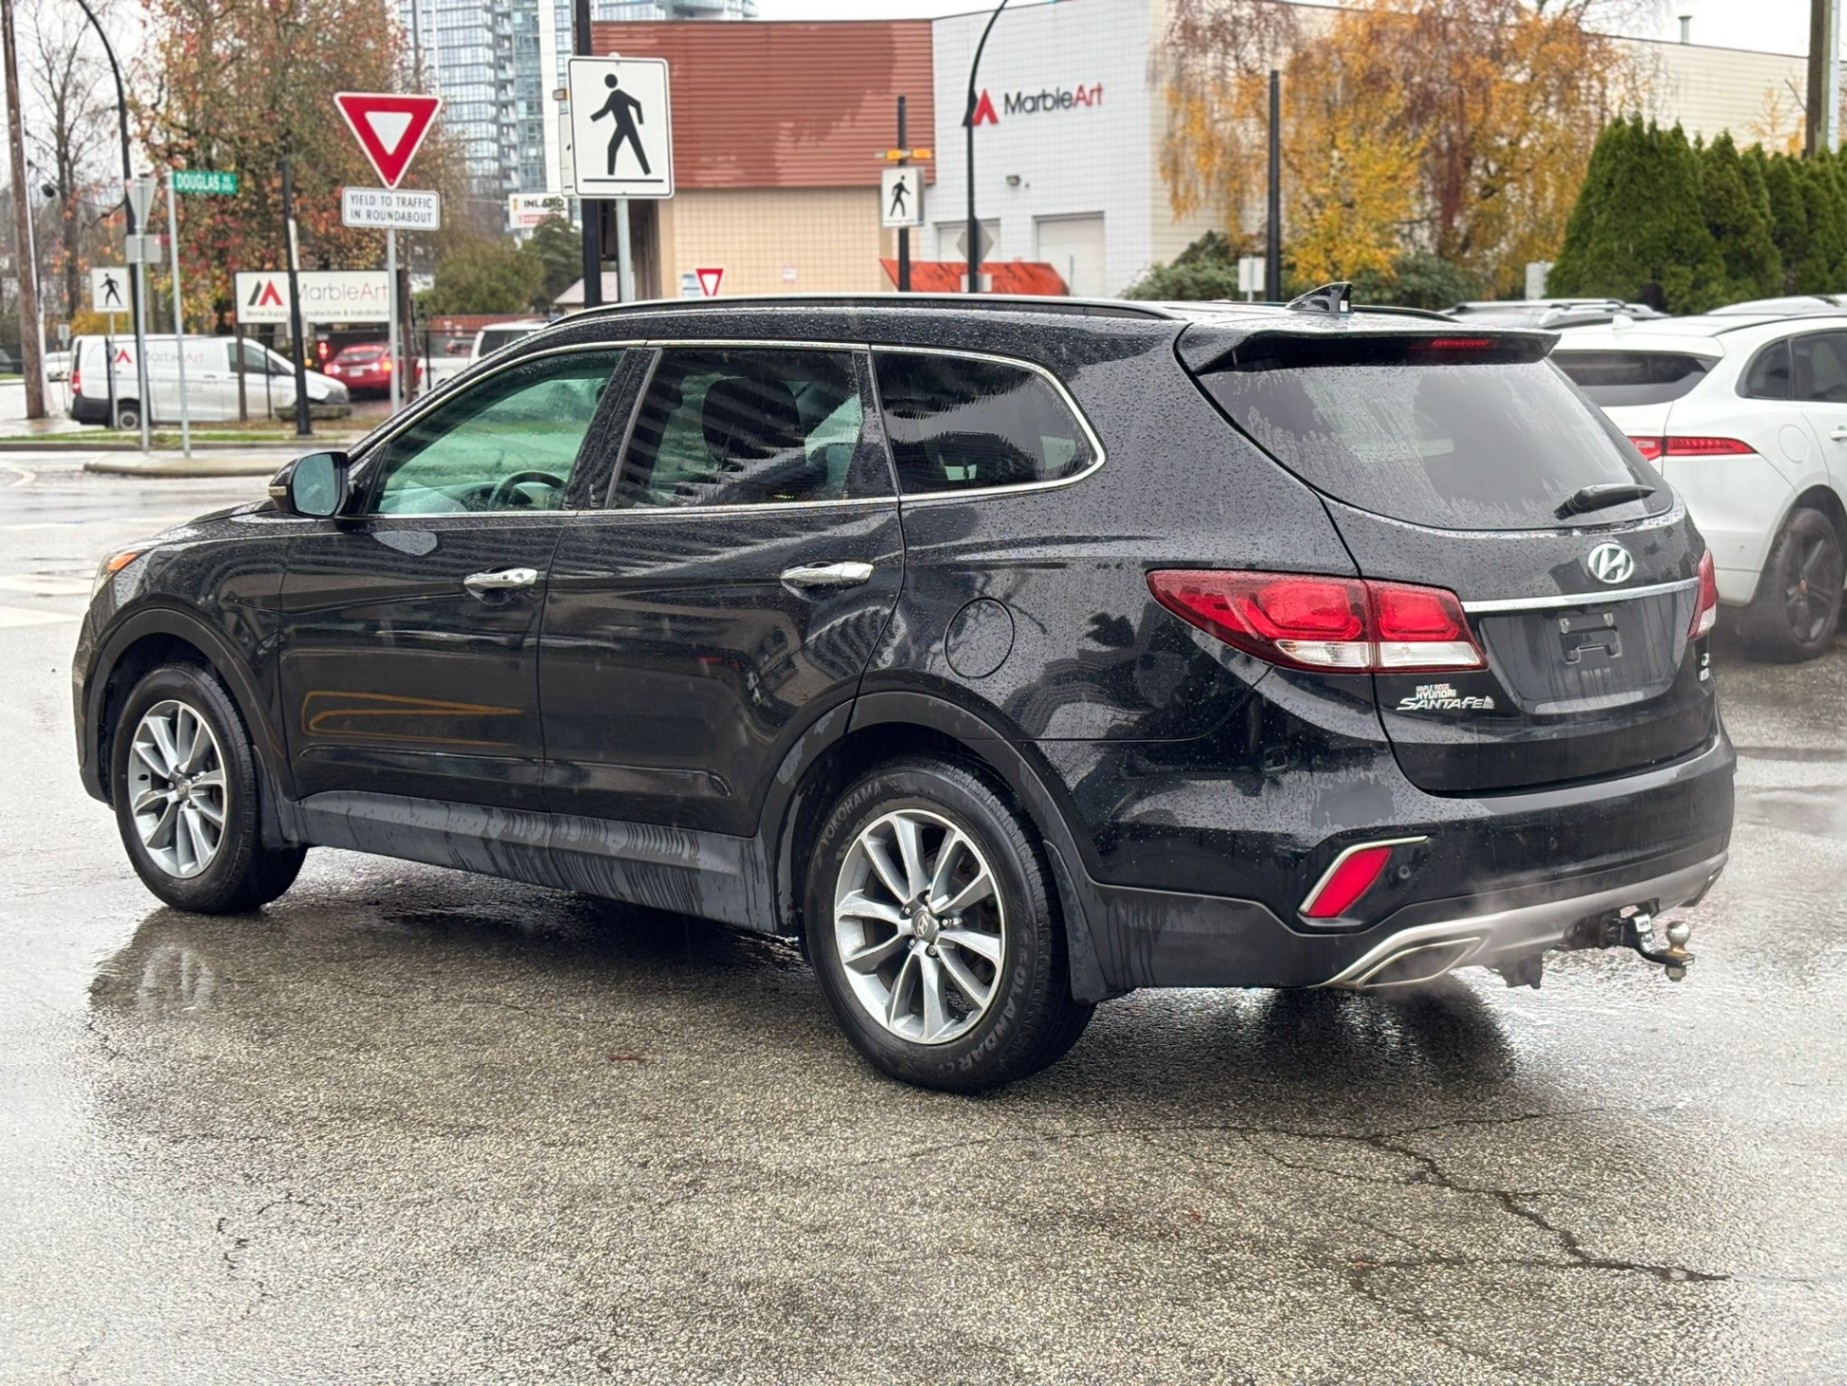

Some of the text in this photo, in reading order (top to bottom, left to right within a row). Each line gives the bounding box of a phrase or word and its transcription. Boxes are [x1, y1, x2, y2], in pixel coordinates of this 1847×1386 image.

[1004, 83, 1103, 115] MarbleArt
[176, 172, 220, 191] DOUGLAS
[350, 194, 433, 209] YIELD TO TRAFFIC
[350, 209, 432, 223] IN ROUNDABOUT
[1416, 689, 1457, 699] HYUNDAI
[821, 781, 881, 846] YOKOHAMA
